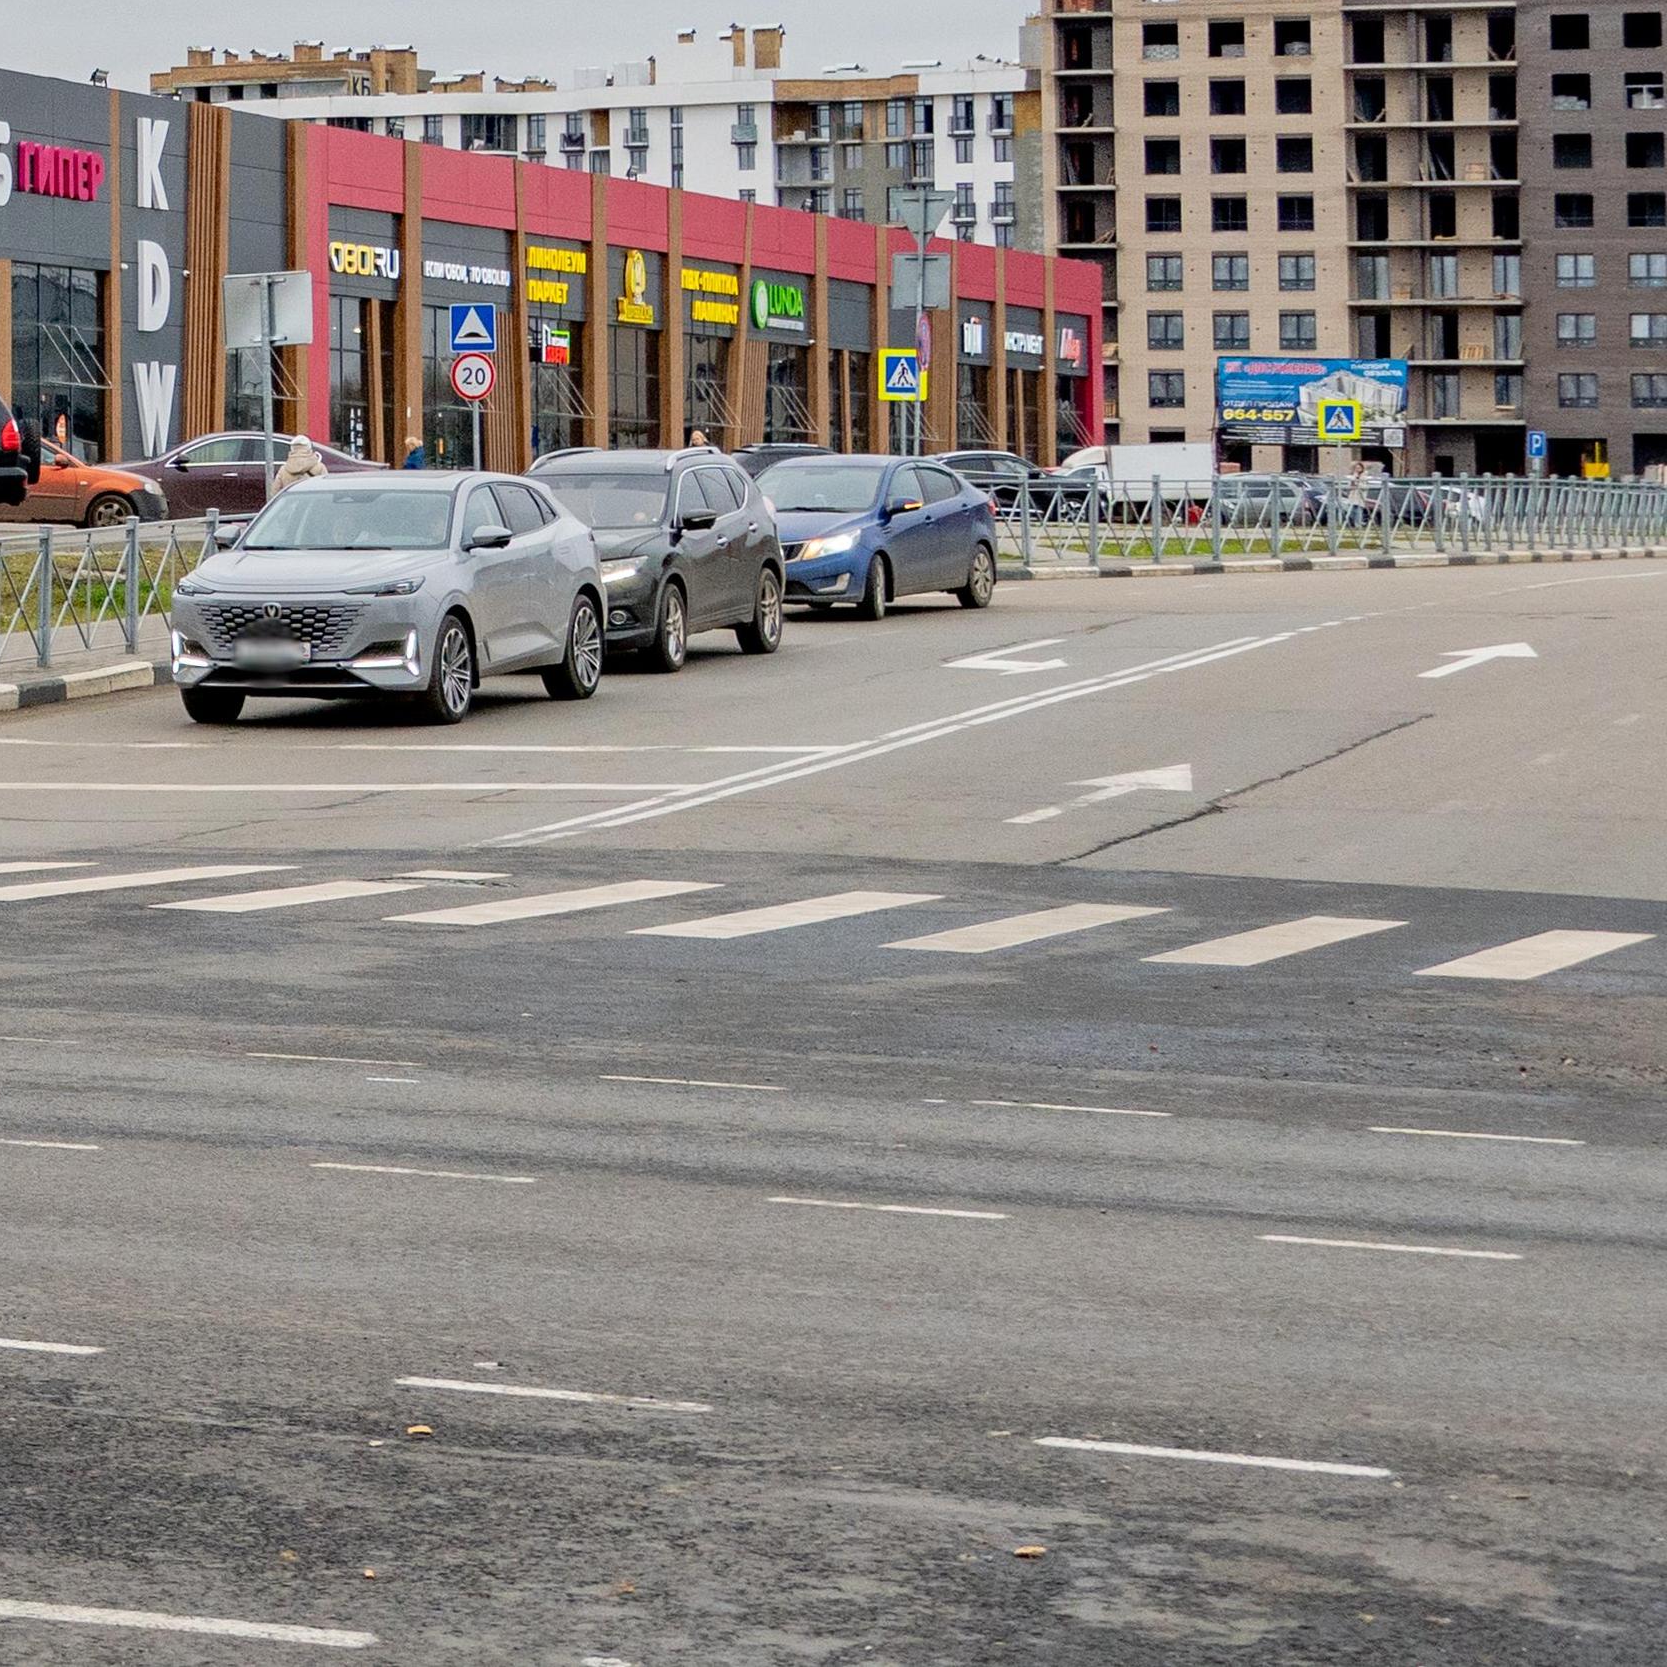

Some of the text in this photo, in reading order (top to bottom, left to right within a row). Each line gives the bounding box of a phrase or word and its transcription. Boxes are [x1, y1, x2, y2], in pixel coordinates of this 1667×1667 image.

[18, 140, 106, 201] ГИПЕР
[527, 246, 586, 274] ЛИНОЛЕУМ
[527, 279, 569, 304] ПАРКЕТ
[769, 284, 804, 317] LUNDA
[462, 367, 486, 385] 20
[1532, 435, 1542, 454] P
